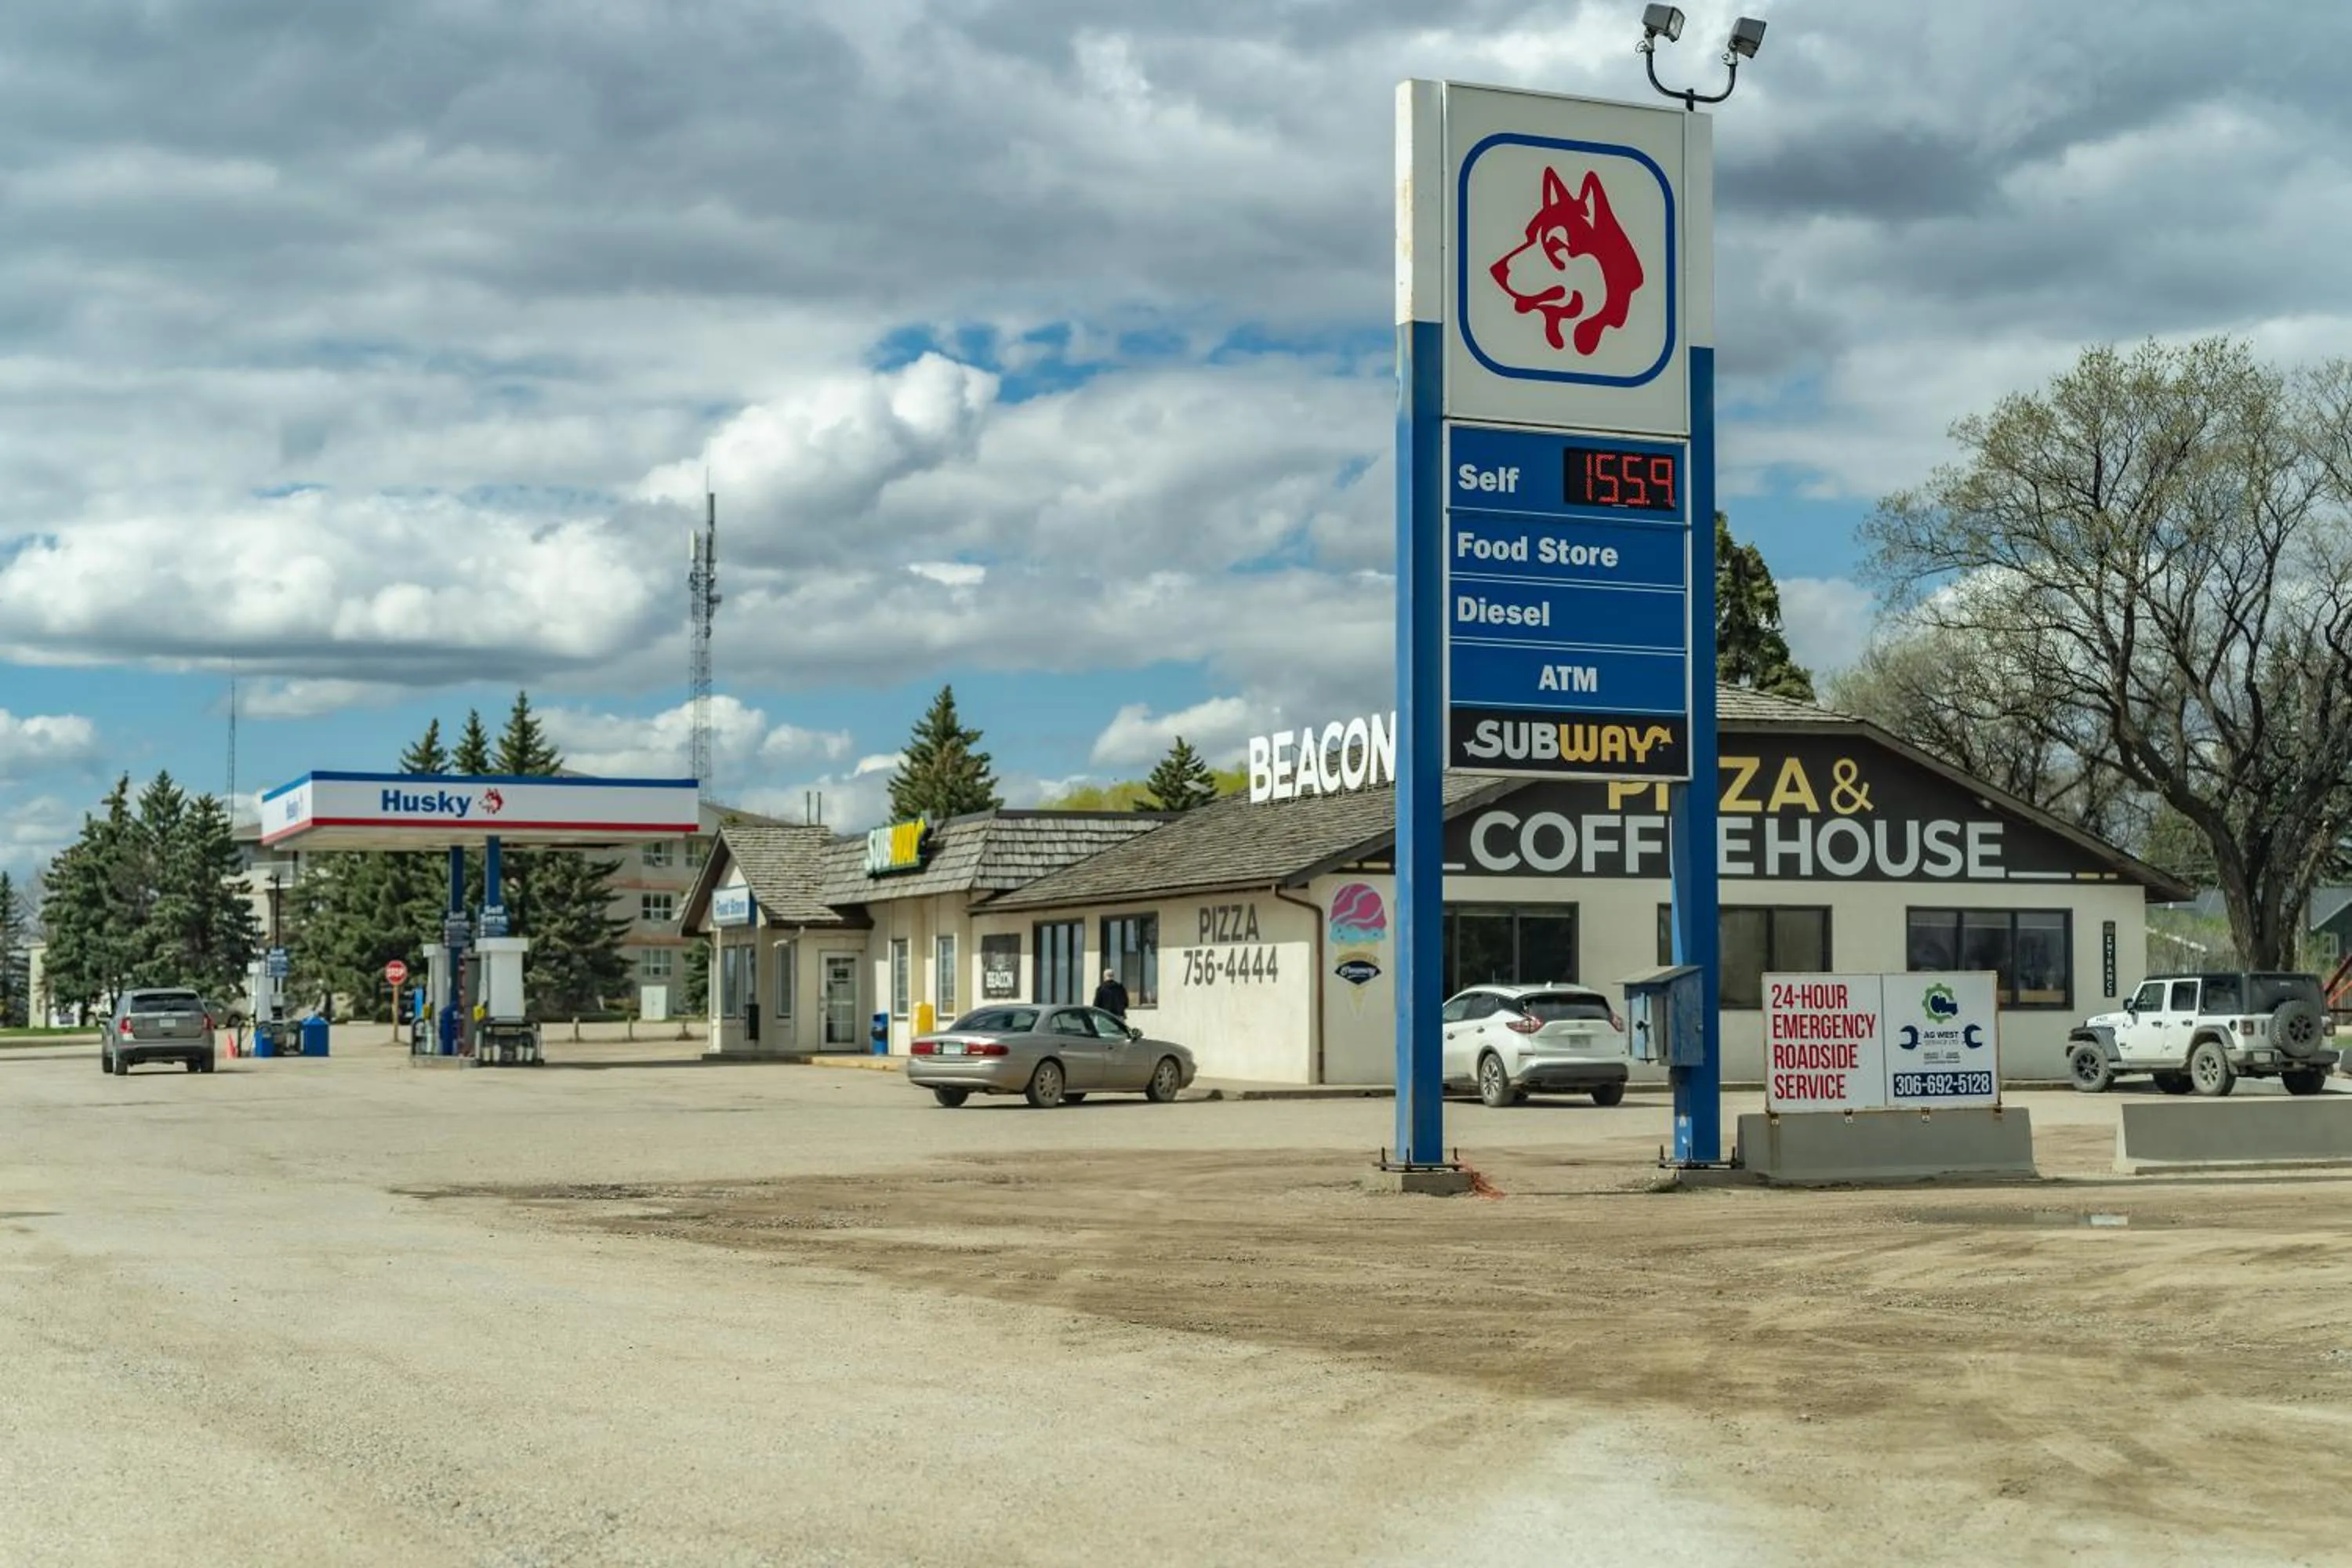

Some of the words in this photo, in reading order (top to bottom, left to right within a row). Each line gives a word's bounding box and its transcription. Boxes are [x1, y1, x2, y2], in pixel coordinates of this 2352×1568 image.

[1458, 463, 1521, 493] Self
[1457, 532, 1528, 561] Food
[1537, 537, 1619, 567] Store
[1457, 596, 1550, 626] Diesel
[1538, 665, 1597, 692] ATM
[1463, 719, 1674, 763] SUBWAY
[1249, 710, 1396, 803] BEACON
[1608, 757, 1820, 812] PIZA
[1831, 758, 1875, 815] &
[381, 789, 471, 818] Husky
[864, 818, 925, 870] SUBWAY
[1199, 903, 1259, 943] PIZZA
[987, 971, 1014, 988] BEACON
[1184, 946, 1278, 986] 756-4444
[1772, 984, 1848, 1009] 24-HOUR
[1773, 1014, 1876, 1039] EMERGENCY
[1773, 1044, 1859, 1069] ROADSIDE
[1774, 1074, 1846, 1099] SERVICE
[1895, 1073, 1990, 1095] 306-692-5128
